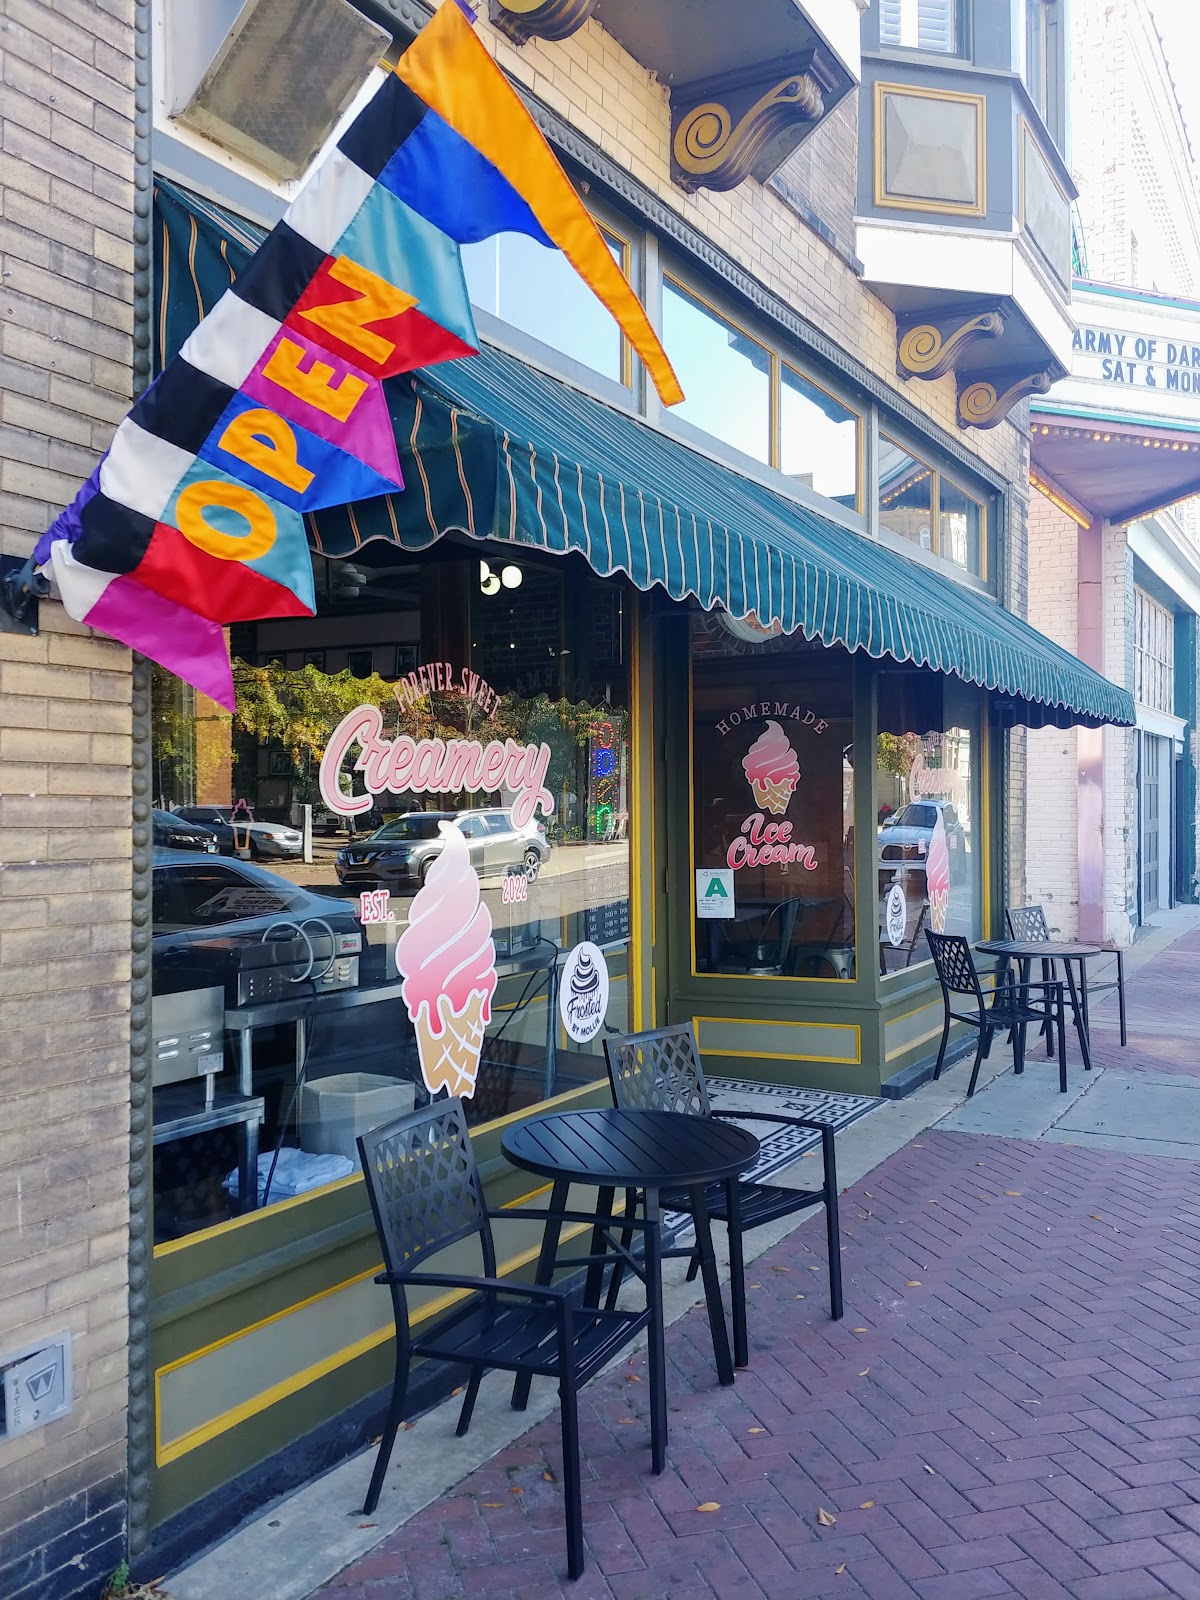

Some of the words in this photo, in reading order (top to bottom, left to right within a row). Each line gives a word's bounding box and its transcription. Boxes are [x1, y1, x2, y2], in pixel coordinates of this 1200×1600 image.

[1072, 328, 1126, 355] ARMY
[1135, 338, 1157, 360] OF
[1167, 344, 1200, 368] DAR
[1102, 359, 1136, 383] SAT
[1146, 366, 1156, 386] &
[1166, 369, 1200, 393] MON
[175, 254, 420, 561] OPEN
[393, 662, 453, 713] FOREVER
[461, 667, 501, 720] SWEET
[715, 702, 829, 736] HOMEMADE
[319, 704, 554, 830] Creamery
[741, 812, 793, 844] Ice
[727, 836, 818, 870] Cream
[502, 875, 528, 903] 2022
[704, 877, 728, 897] A
[360, 889, 395, 924] EST.
[589, 924, 597, 932] SAT
[567, 993, 602, 1024] Frosted
[571, 1023, 580, 1035] BY
[580, 1016, 601, 1037] MOLLIE
[12, 1376, 21, 1427] WATER
